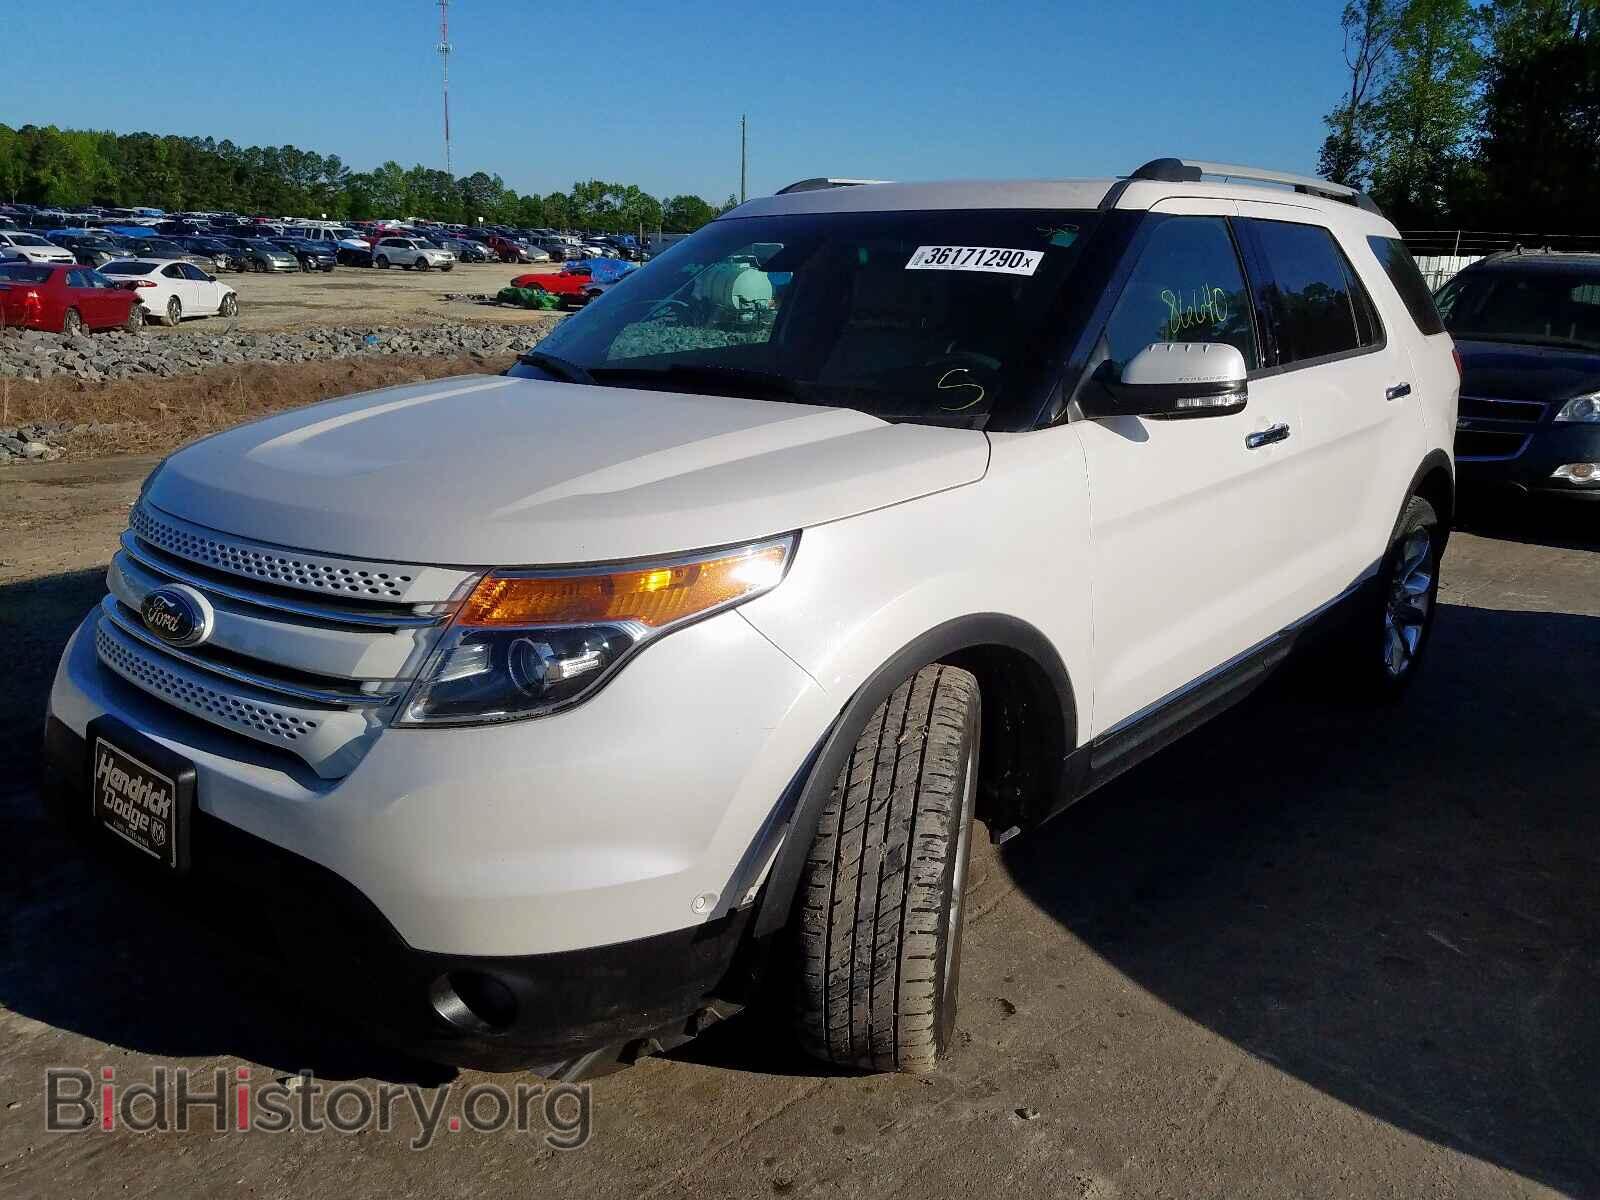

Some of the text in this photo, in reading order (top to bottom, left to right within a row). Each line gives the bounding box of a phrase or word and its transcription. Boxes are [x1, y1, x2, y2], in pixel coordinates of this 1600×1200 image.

[148, 595, 183, 632] Ford
[97, 752, 171, 817] Hendrick
[103, 787, 150, 831] Dodge
